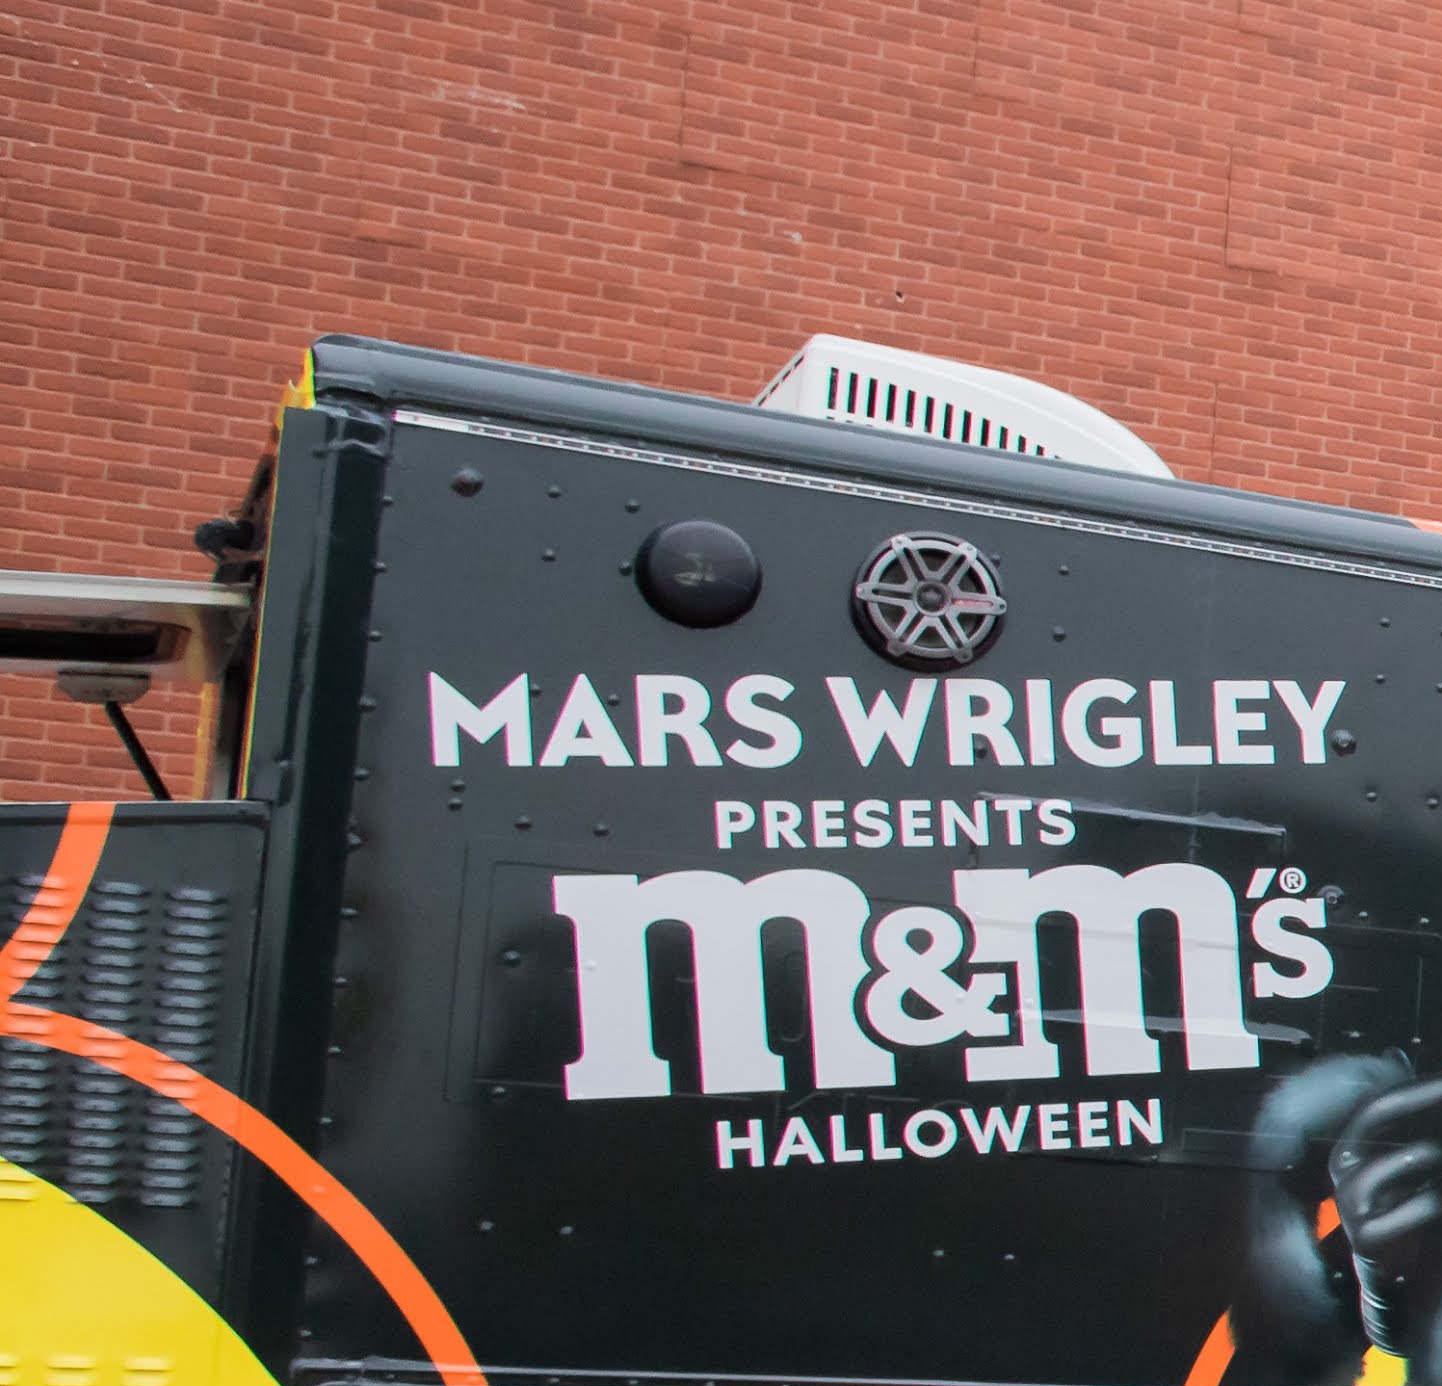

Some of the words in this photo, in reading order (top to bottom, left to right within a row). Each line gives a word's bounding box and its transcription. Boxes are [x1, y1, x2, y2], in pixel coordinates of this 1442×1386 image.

[429, 671, 802, 768] MARS
[825, 675, 1348, 768] WRIGLEY
[715, 798, 1077, 849] PRESENTS
[716, 1097, 1163, 1169] HALLOWEEN
